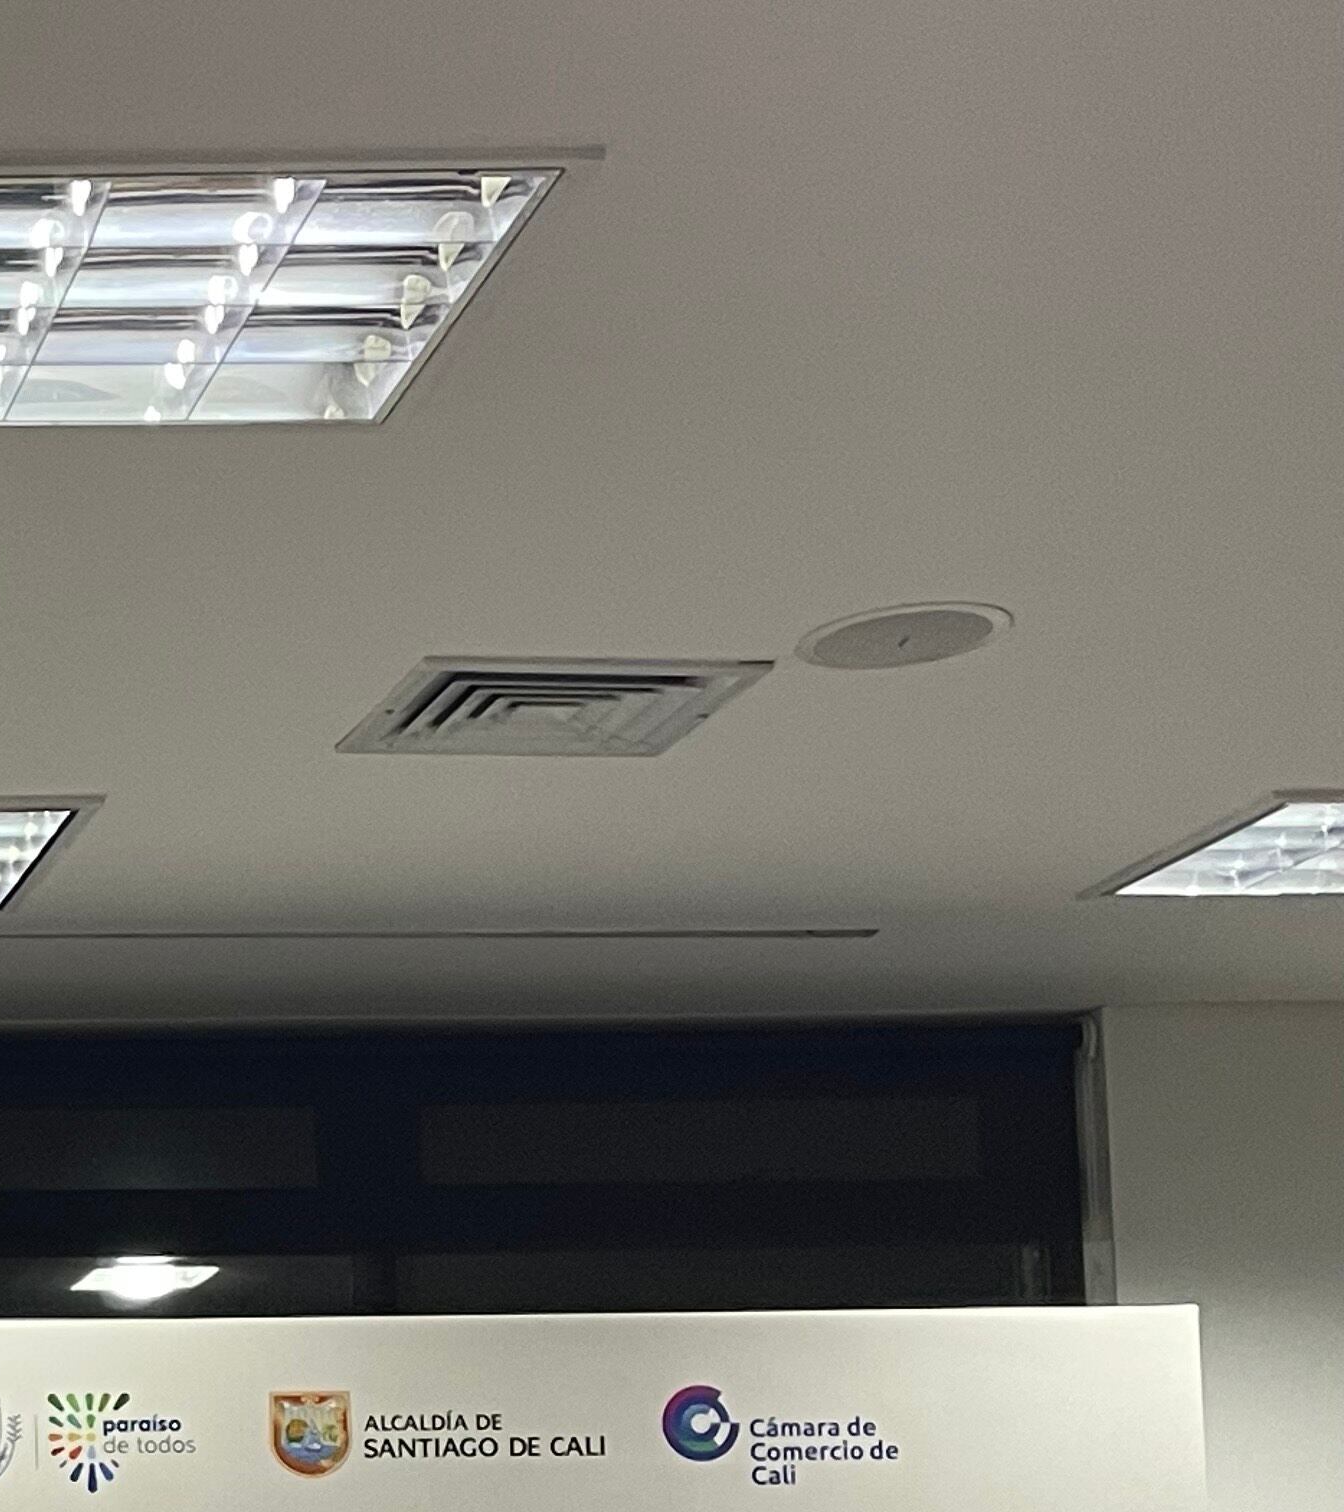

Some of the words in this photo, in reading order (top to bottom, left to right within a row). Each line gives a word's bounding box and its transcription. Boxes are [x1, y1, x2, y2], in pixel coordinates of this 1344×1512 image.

[102, 1419, 182, 1437] paraíso
[364, 1409, 469, 1432] ALCALDÍA
[475, 1413, 503, 1431] DE
[749, 1416, 840, 1438] Cámara
[846, 1415, 877, 1437] de
[103, 1437, 129, 1454] de
[136, 1435, 197, 1454] todos
[363, 1436, 499, 1459] SANTIAGO
[509, 1436, 541, 1457] DE
[549, 1435, 606, 1457] CALI
[750, 1439, 864, 1462] Comercio
[869, 1439, 899, 1460] de
[751, 1464, 796, 1486] Cali
